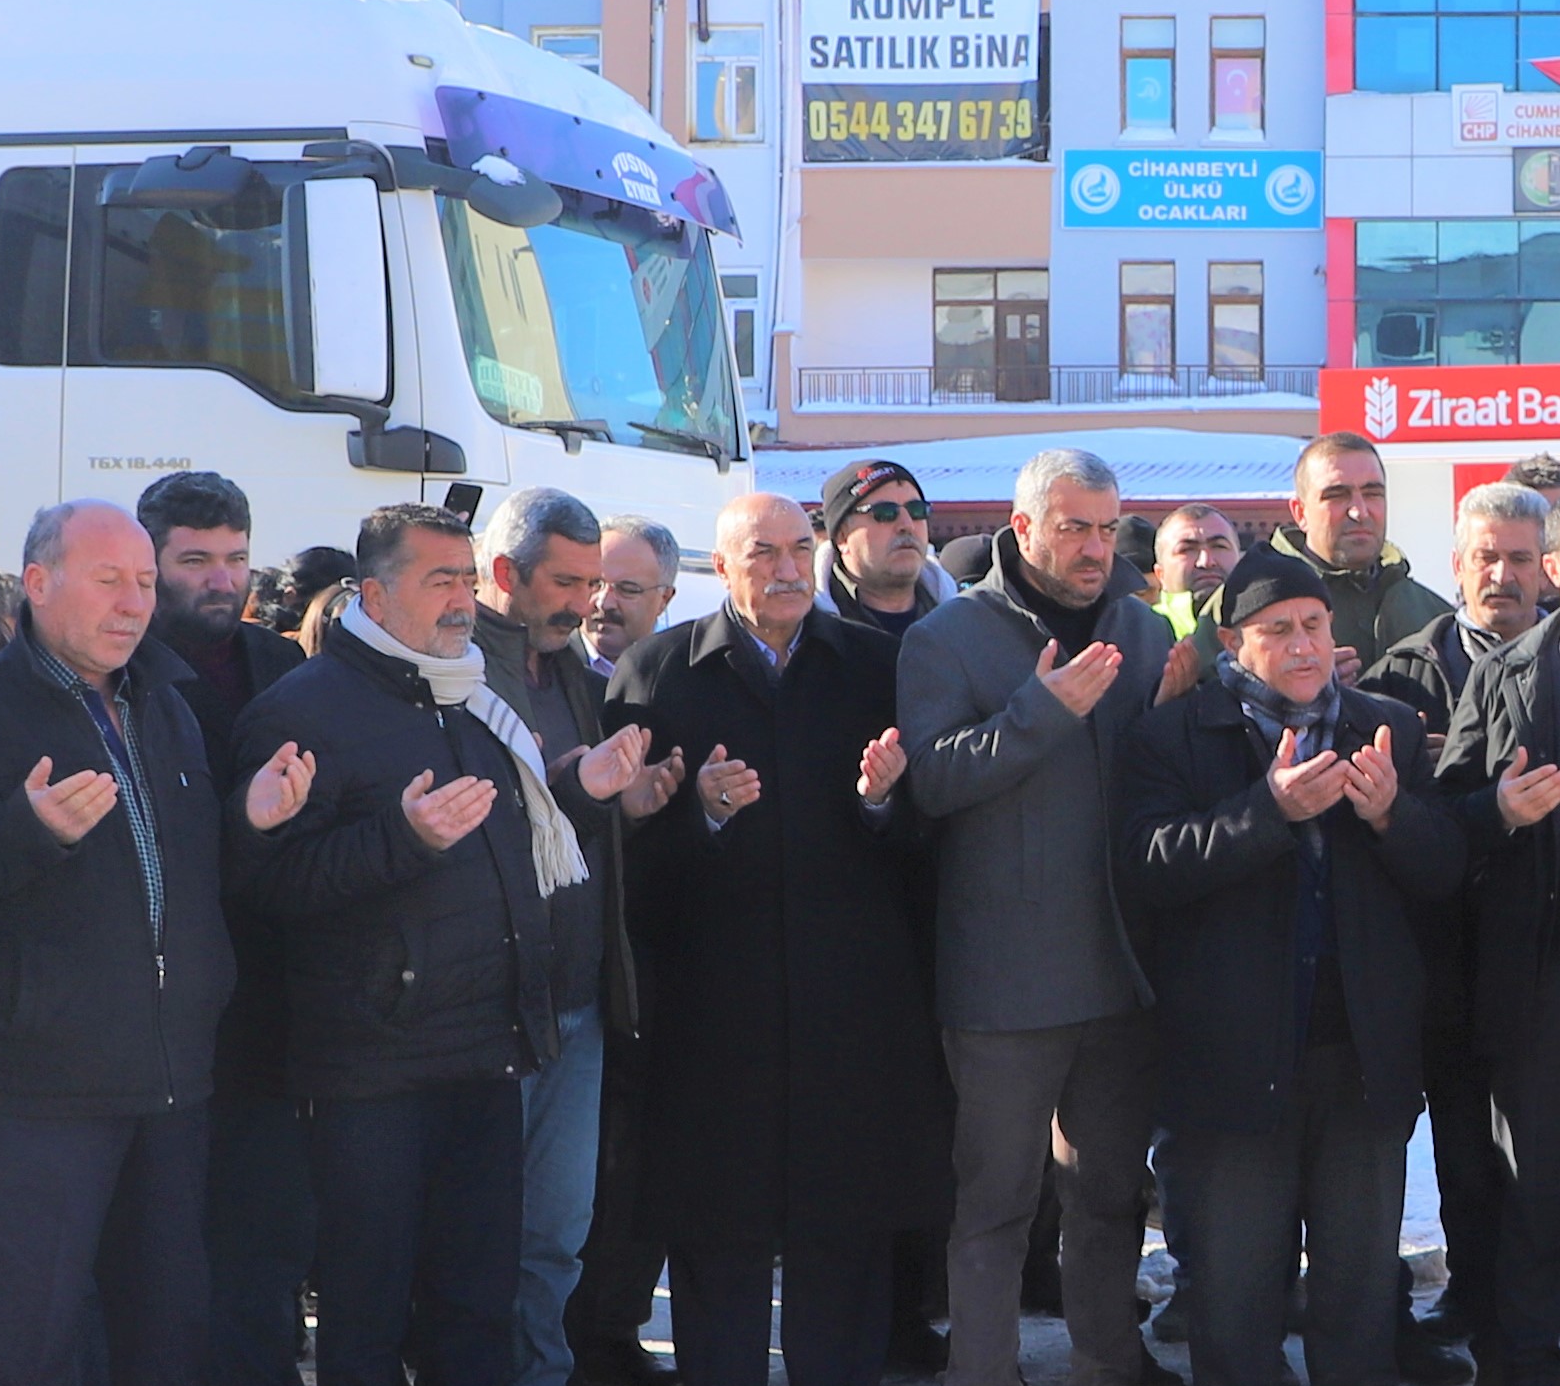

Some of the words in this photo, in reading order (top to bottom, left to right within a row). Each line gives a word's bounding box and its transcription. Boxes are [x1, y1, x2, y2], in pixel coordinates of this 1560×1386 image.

[810, 35, 940, 70] SATILIK
[809, 100, 890, 141] 0544
[896, 100, 952, 141] 347
[958, 100, 993, 141] 67
[999, 98, 1033, 141] 39
[1463, 125, 1497, 139] CHP
[1128, 158, 1258, 178] CİHANBEYLİ
[1163, 180, 1223, 199] ÜLKÜ
[1138, 204, 1247, 221] OCAKLARI
[1407, 389, 1512, 428] Ziraat
[88, 456, 124, 470] TGX
[126, 456, 192, 470] 18.440
